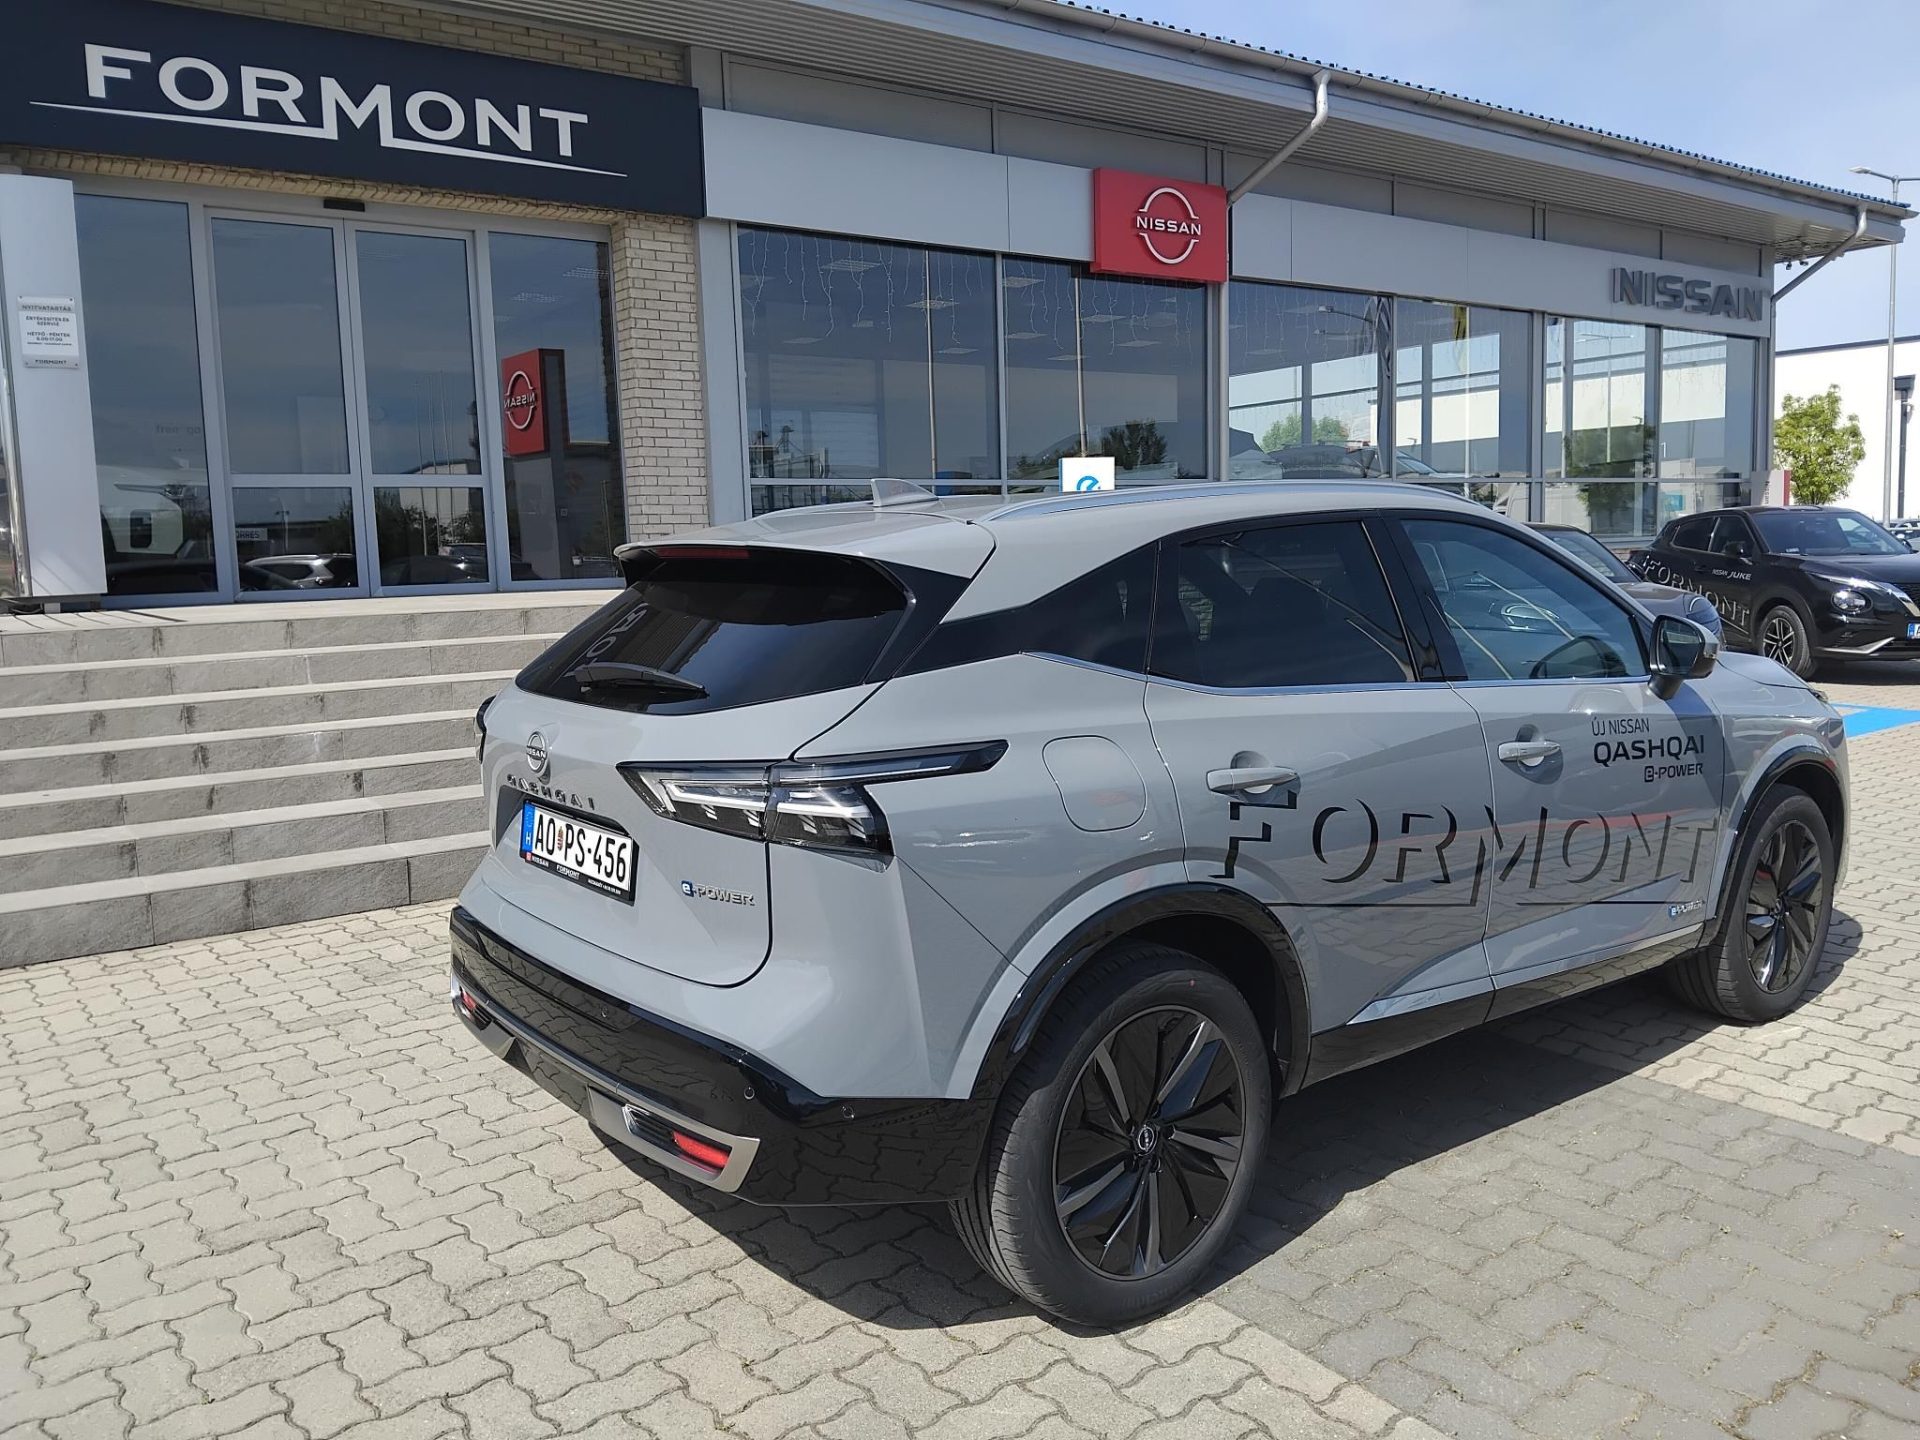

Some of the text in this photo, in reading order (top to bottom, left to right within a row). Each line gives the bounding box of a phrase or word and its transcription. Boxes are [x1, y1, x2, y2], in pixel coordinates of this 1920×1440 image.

[84, 43, 588, 157] FORMONT
[1136, 215, 1201, 236] NISSAN
[1609, 267, 1763, 321] NISSAN
[1728, 571, 1751, 580] JUKE
[1592, 717, 1650, 736] ÚJ NISSAN
[1593, 735, 1704, 767] QASHQAI
[535, 814, 556, 856] AO
[1208, 791, 1718, 907] FORMONT
